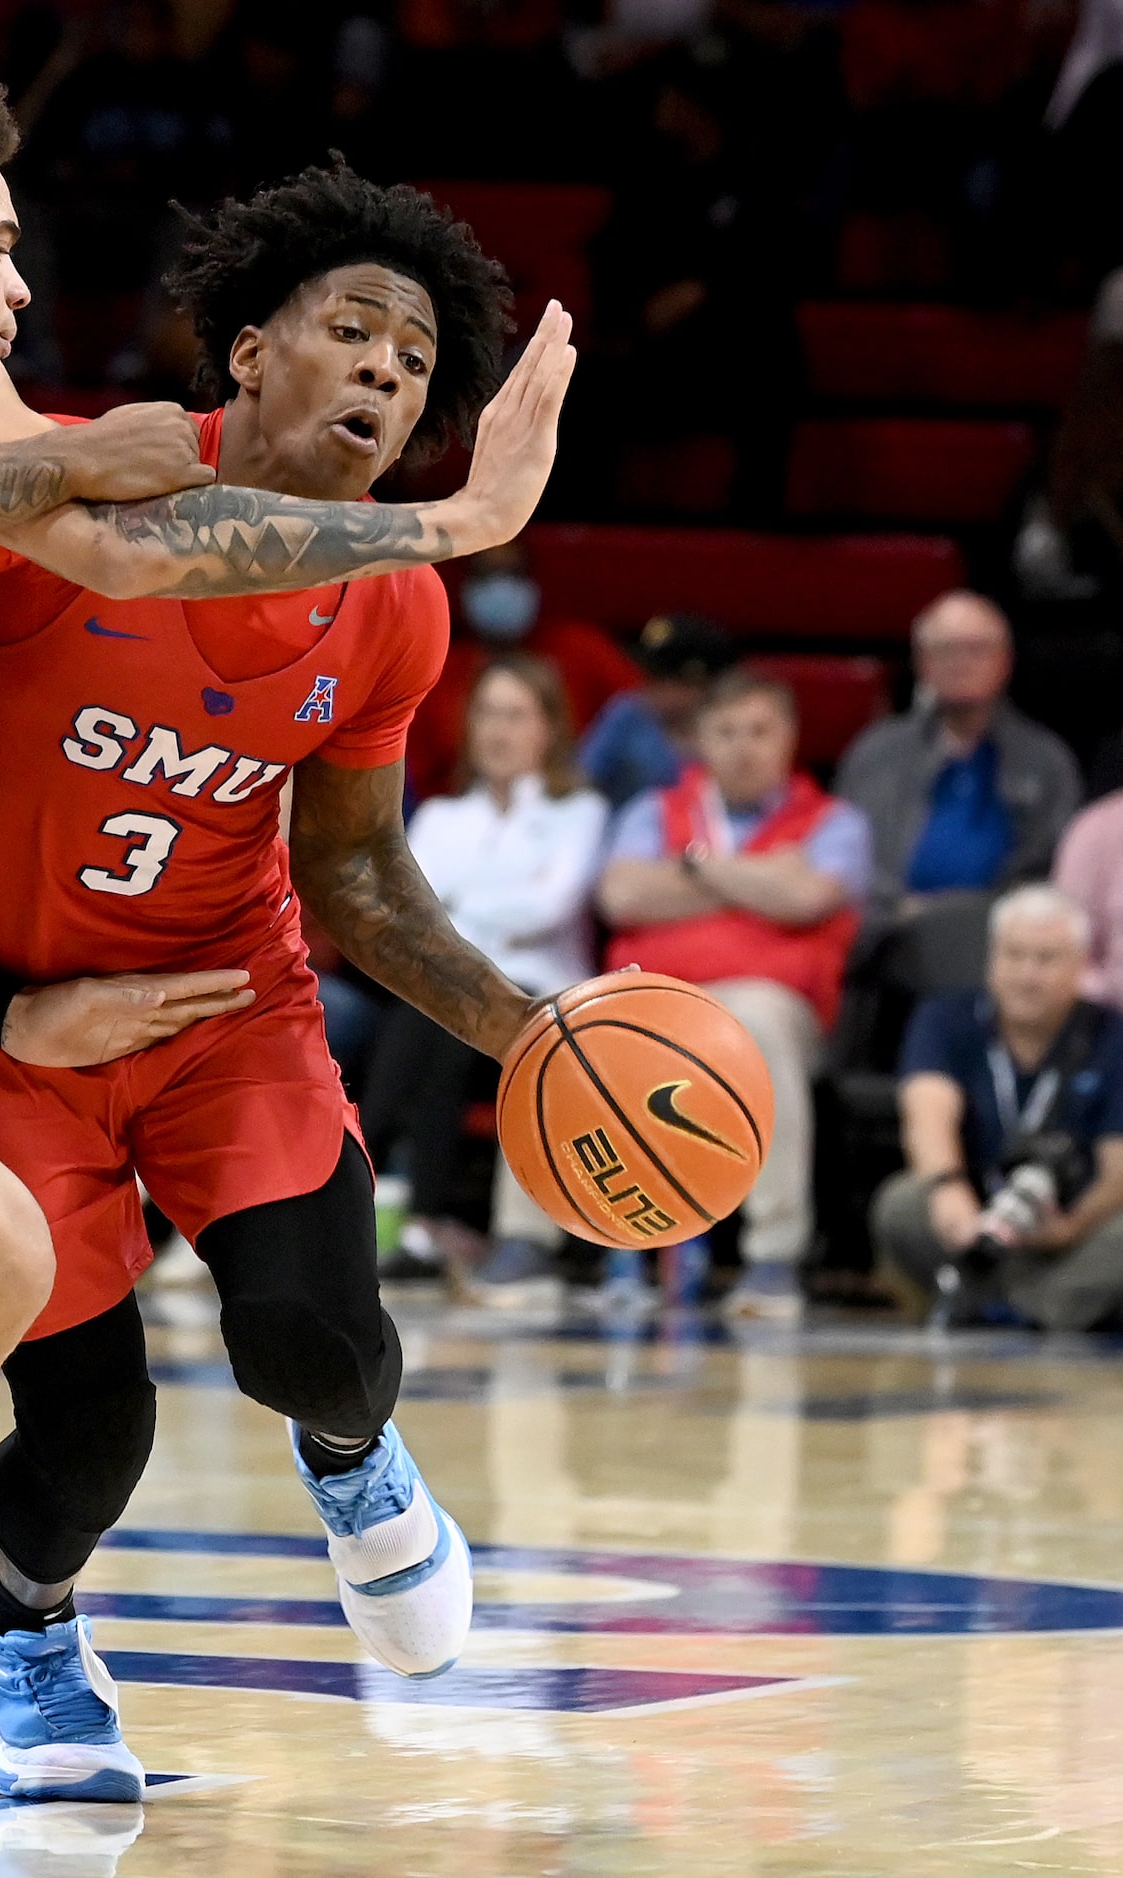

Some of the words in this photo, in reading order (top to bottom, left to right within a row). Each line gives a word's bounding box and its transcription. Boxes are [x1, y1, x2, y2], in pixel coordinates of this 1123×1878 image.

[61, 704, 289, 804] SMU
[78, 809, 183, 897] 3
[570, 1126, 680, 1239] ELITE
